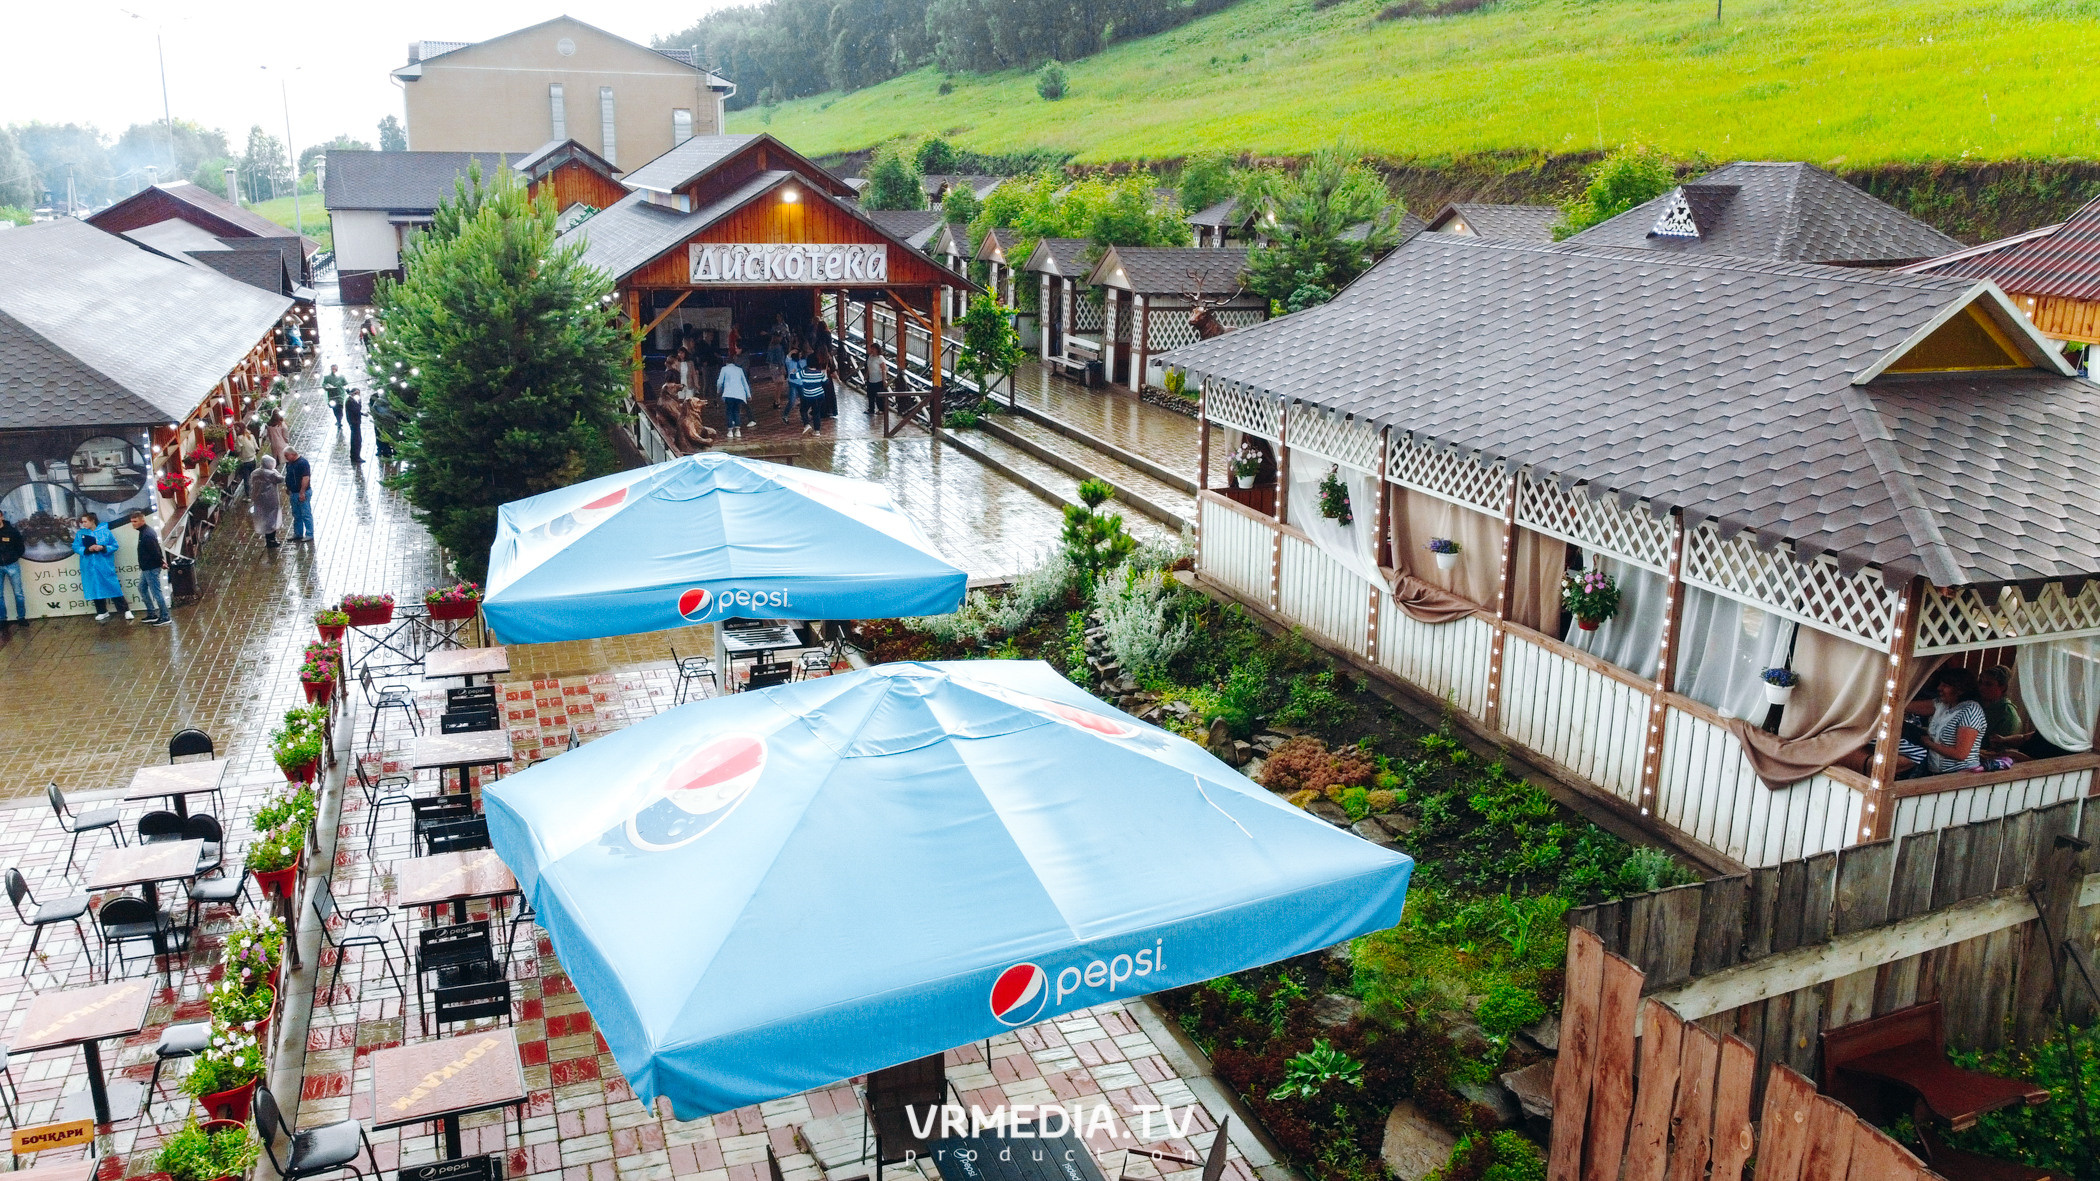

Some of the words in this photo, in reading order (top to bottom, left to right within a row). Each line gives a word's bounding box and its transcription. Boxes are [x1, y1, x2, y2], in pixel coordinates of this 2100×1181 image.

[34, 570, 55, 581] ул.
[58, 583, 67, 593] 8
[718, 587, 788, 613] pepsi
[449, 925, 474, 936] pepsi
[1056, 938, 1163, 1006] pepsi
[21, 1127, 84, 1146] БОЧКАРИ
[438, 1161, 470, 1175] pepsi
[960, 1158, 977, 1177] pepsi
